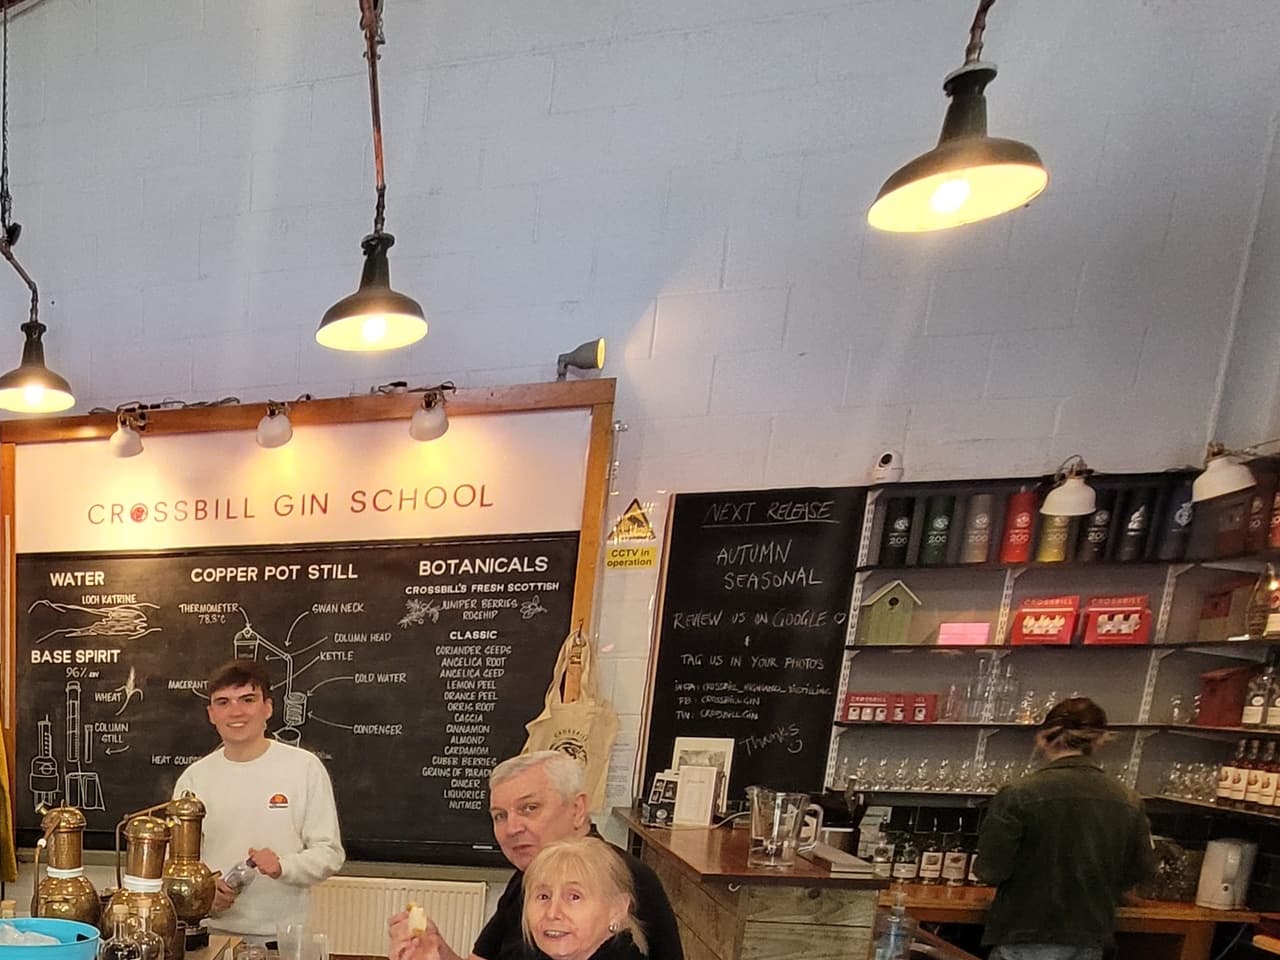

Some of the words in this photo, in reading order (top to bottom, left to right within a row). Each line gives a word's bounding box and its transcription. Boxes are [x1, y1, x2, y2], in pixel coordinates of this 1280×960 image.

[88, 498, 256, 525] CROSSBILL
[274, 493, 329, 517] GIN
[350, 484, 494, 513] SCHOOL
[704, 502, 756, 522] NEXT
[767, 501, 834, 521] RELEASE
[611, 549, 638, 557] CCTV
[717, 539, 792, 566] AUTUMN
[419, 556, 549, 576] BOTANICALS
[607, 559, 652, 568] operation
[50, 571, 105, 586] WATER
[191, 567, 257, 583] COPPER
[265, 566, 300, 581] POT
[308, 564, 358, 580] STILL
[724, 567, 822, 590] SEASONAL
[405, 583, 467, 595] CROSSBILL'S
[471, 583, 504, 593] FRESH
[507, 582, 560, 592] SCOTTISH
[82, 595, 99, 605] LOCH
[101, 593, 137, 604] KATRINE
[441, 599, 477, 609] JUNIPER
[481, 599, 518, 608] BERRIES
[178, 603, 239, 613] THERMOMETER
[312, 604, 338, 613] SWAN
[340, 603, 364, 613] NECK
[462, 610, 498, 620] ROSEHIP
[673, 610, 723, 629] REVIEW
[732, 612, 746, 624] US
[754, 613, 768, 624] ON
[772, 608, 828, 628] GOOGLE
[334, 633, 368, 643] COLUMN
[370, 632, 392, 642] HEAD
[449, 631, 497, 640] CLASSIC
[435, 645, 482, 655] CORIANDER
[484, 645, 512, 654] SEEDS
[31, 650, 72, 663] BASE
[75, 649, 121, 663] SPIRIT
[320, 651, 354, 661] KETTLE
[441, 657, 482, 667] ANGELICA
[485, 657, 507, 666] ROOT
[680, 653, 703, 666] TAG
[710, 655, 723, 666] US
[730, 656, 742, 667] IN
[751, 655, 778, 668] YOUR
[784, 656, 824, 670] PHOTOS
[65, 667, 88, 678] 96%
[440, 668, 481, 678] ANGELICA
[483, 668, 504, 678] SEED
[354, 673, 375, 683] COLD
[377, 673, 407, 683] WATER
[168, 680, 209, 690] MACERANT
[447, 680, 476, 690] LEMON
[477, 680, 496, 689] PEEL
[94, 692, 122, 702] WHEAT
[444, 691, 476, 700] ORANGE
[477, 691, 498, 700] PEEL
[447, 702, 474, 712] ORRIS
[475, 702, 496, 711] ROOT
[454, 713, 483, 723] CASSIA
[94, 722, 129, 733] COLUMN
[353, 724, 403, 735] CONDENSER
[446, 724, 490, 734] CINNAMON
[101, 734, 123, 744] STILL
[450, 736, 485, 745] ALMOND
[444, 745, 489, 755] CARDAMOM
[151, 755, 171, 764] HEAT
[461, 756, 497, 766] BERRIES
[422, 767, 452, 777] GRAINS
[452, 767, 464, 777] OF
[464, 768, 492, 777] PARADI
[451, 778, 480, 788] GINGER
[443, 789, 486, 800] LIQUORICE
[449, 800, 482, 810] NUTMEG
